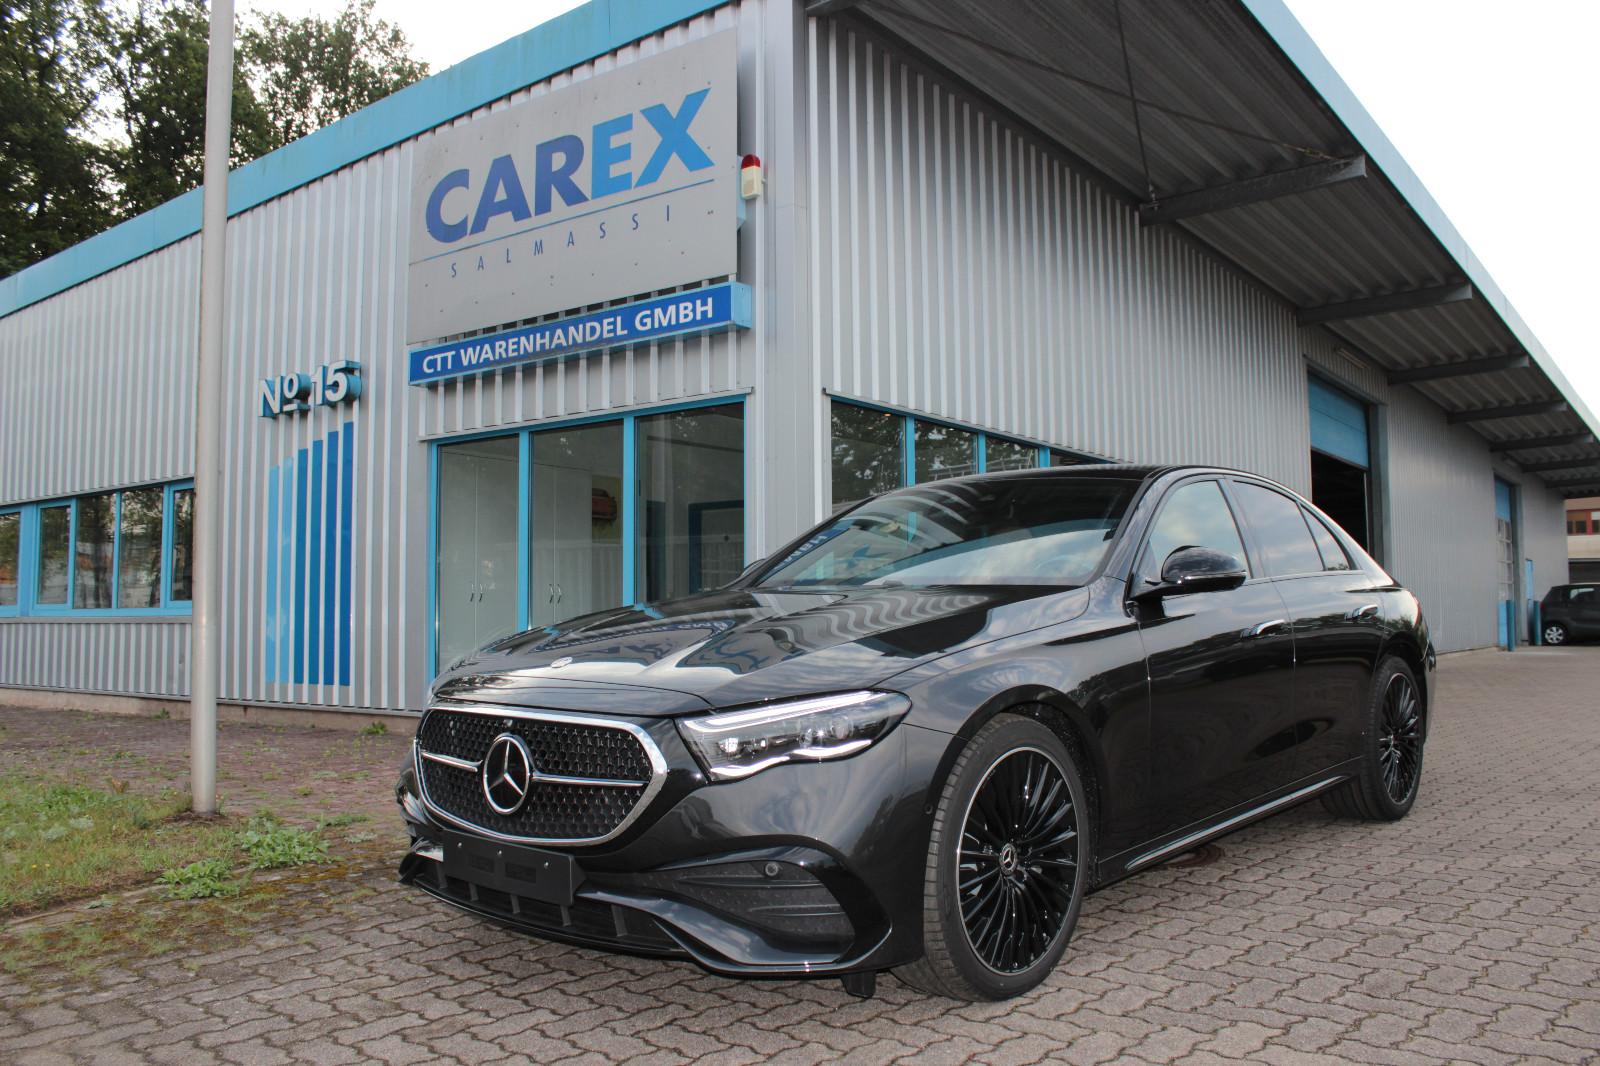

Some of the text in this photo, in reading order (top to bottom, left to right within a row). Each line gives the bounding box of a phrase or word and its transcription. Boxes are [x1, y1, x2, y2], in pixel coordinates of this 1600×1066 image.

[425, 87, 716, 244] CAREX
[451, 204, 670, 278] SALMASSI
[422, 296, 713, 374] CTT WARENHANDEL GMBH
[312, 359, 357, 406] 15
